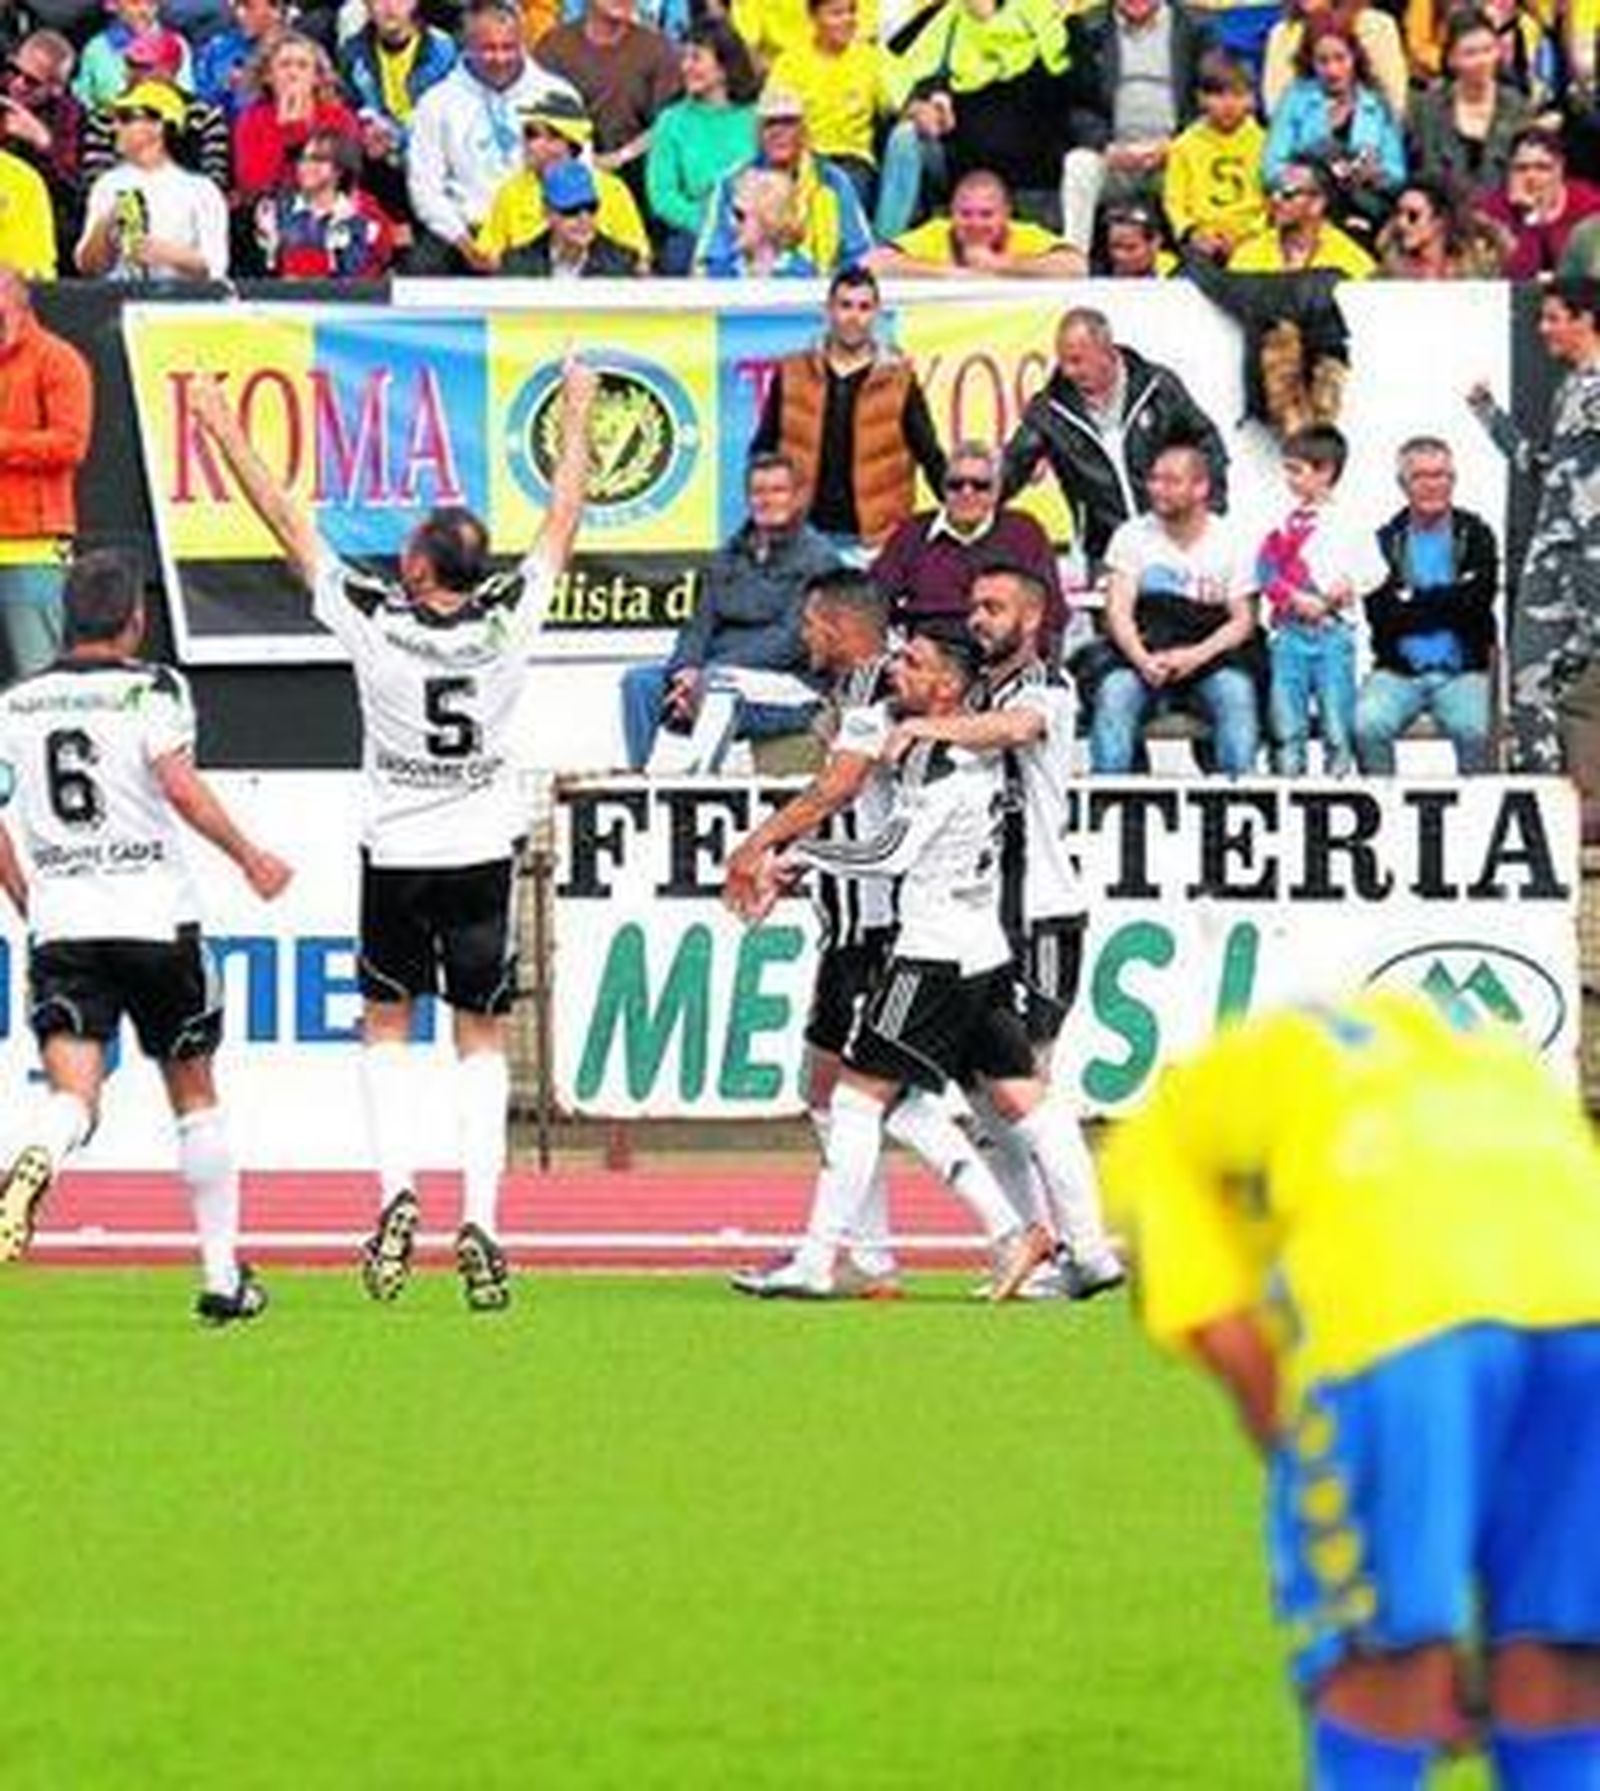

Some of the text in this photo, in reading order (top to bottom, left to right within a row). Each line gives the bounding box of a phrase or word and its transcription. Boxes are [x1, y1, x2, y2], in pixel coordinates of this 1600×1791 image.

[166, 366, 466, 507] KOMA
[424, 677, 479, 757] 5
[46, 728, 102, 827] 6
[557, 788, 1570, 901] FETERIA
